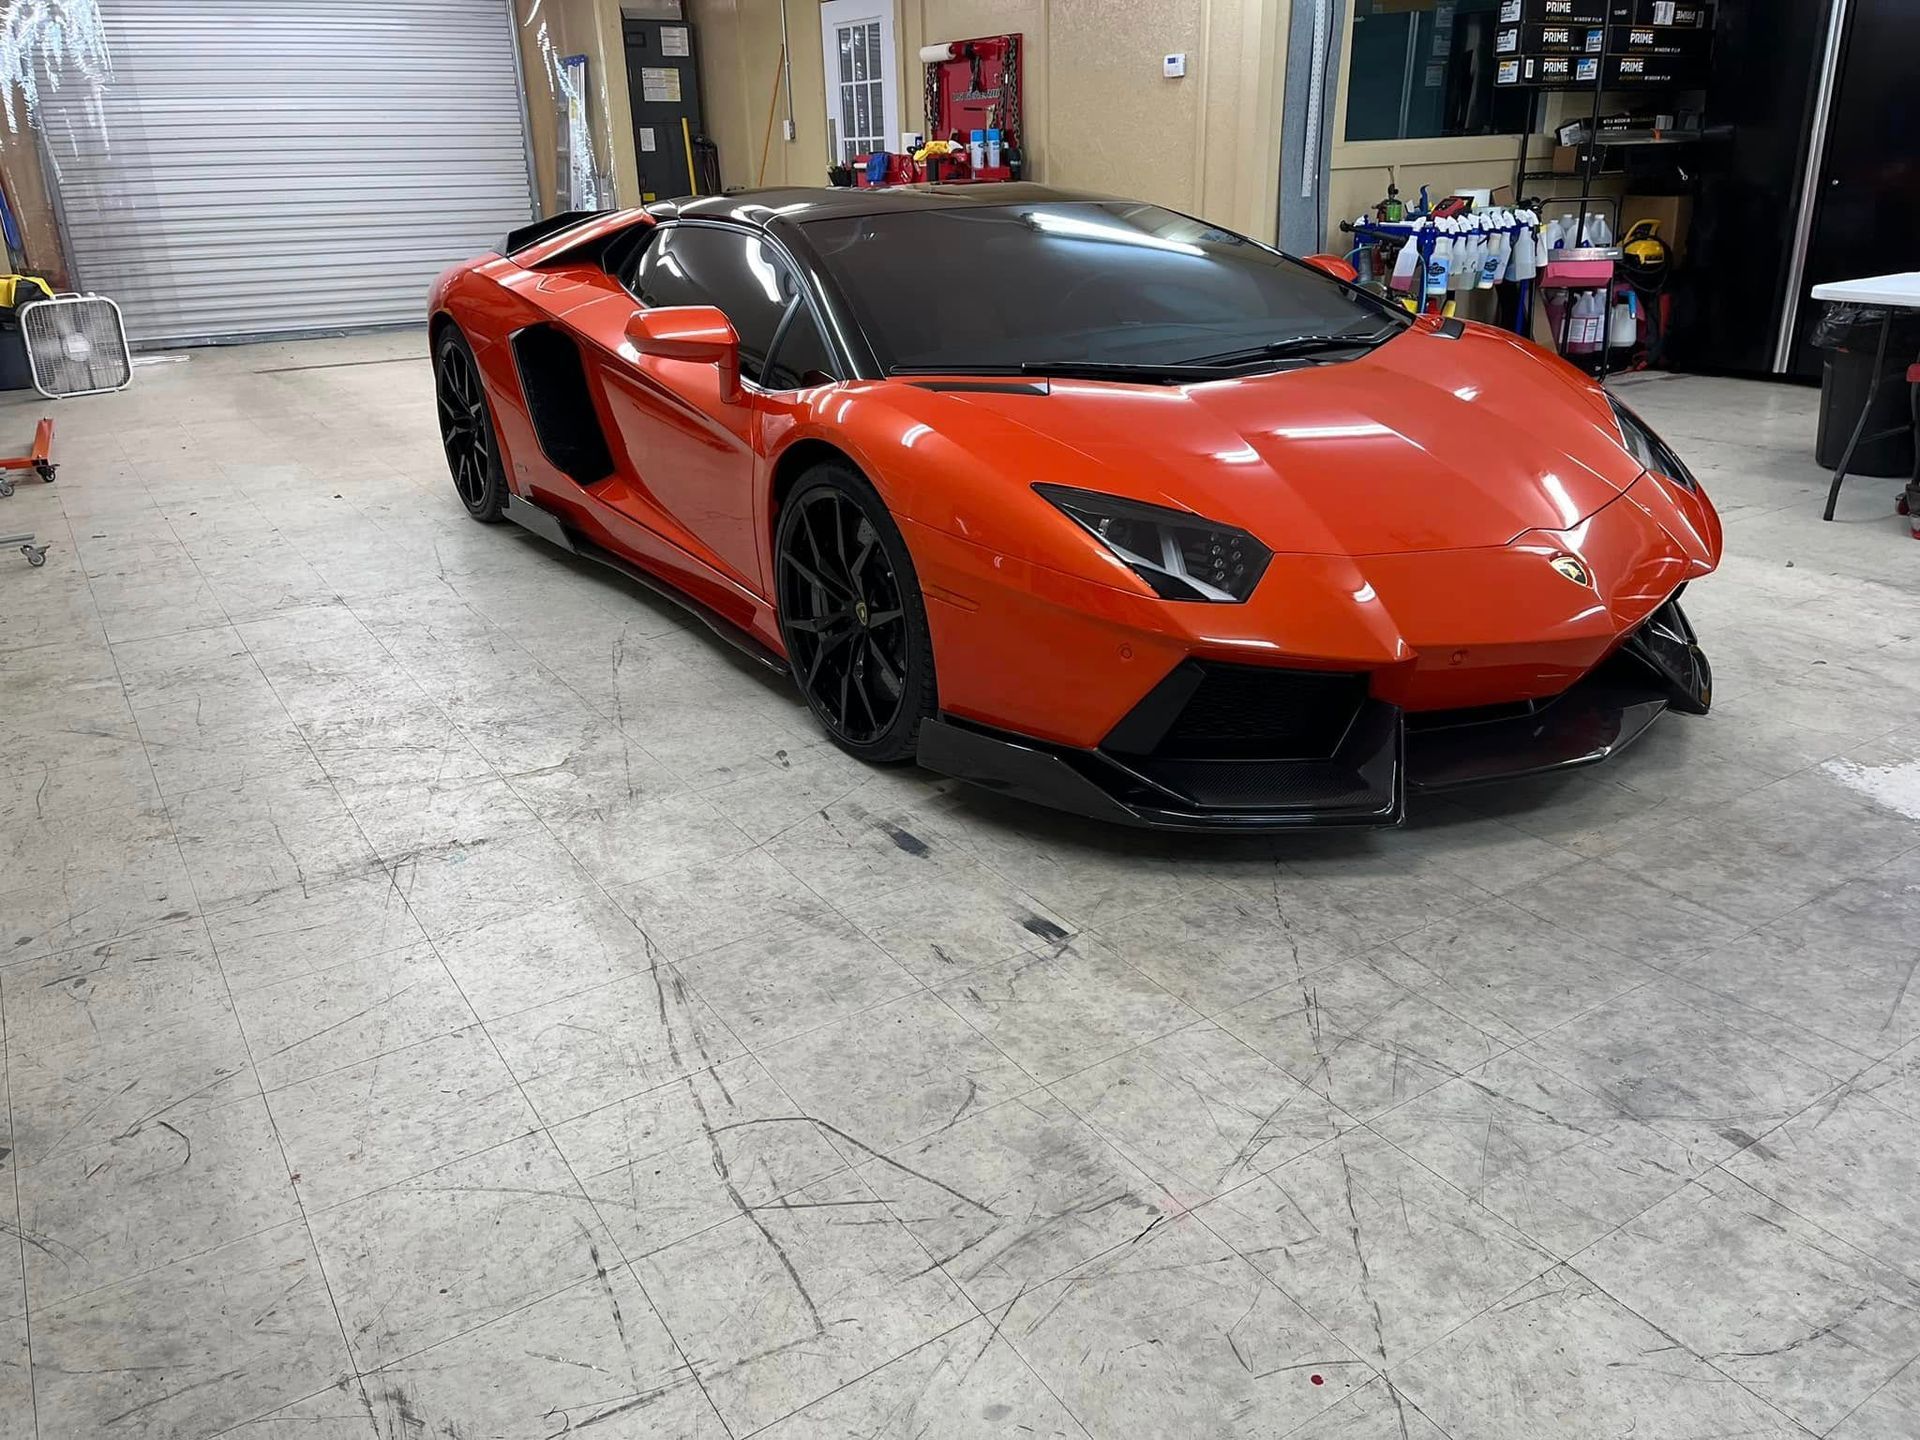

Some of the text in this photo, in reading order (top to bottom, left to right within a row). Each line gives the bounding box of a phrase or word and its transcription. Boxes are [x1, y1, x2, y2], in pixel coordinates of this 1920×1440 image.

[1545, 1, 1572, 13] PRIME
[1542, 31, 1569, 43] PRIME
[1629, 32, 1654, 44] PRIME
[1542, 61, 1569, 73] PRIME
[1619, 61, 1644, 73] PRIME
